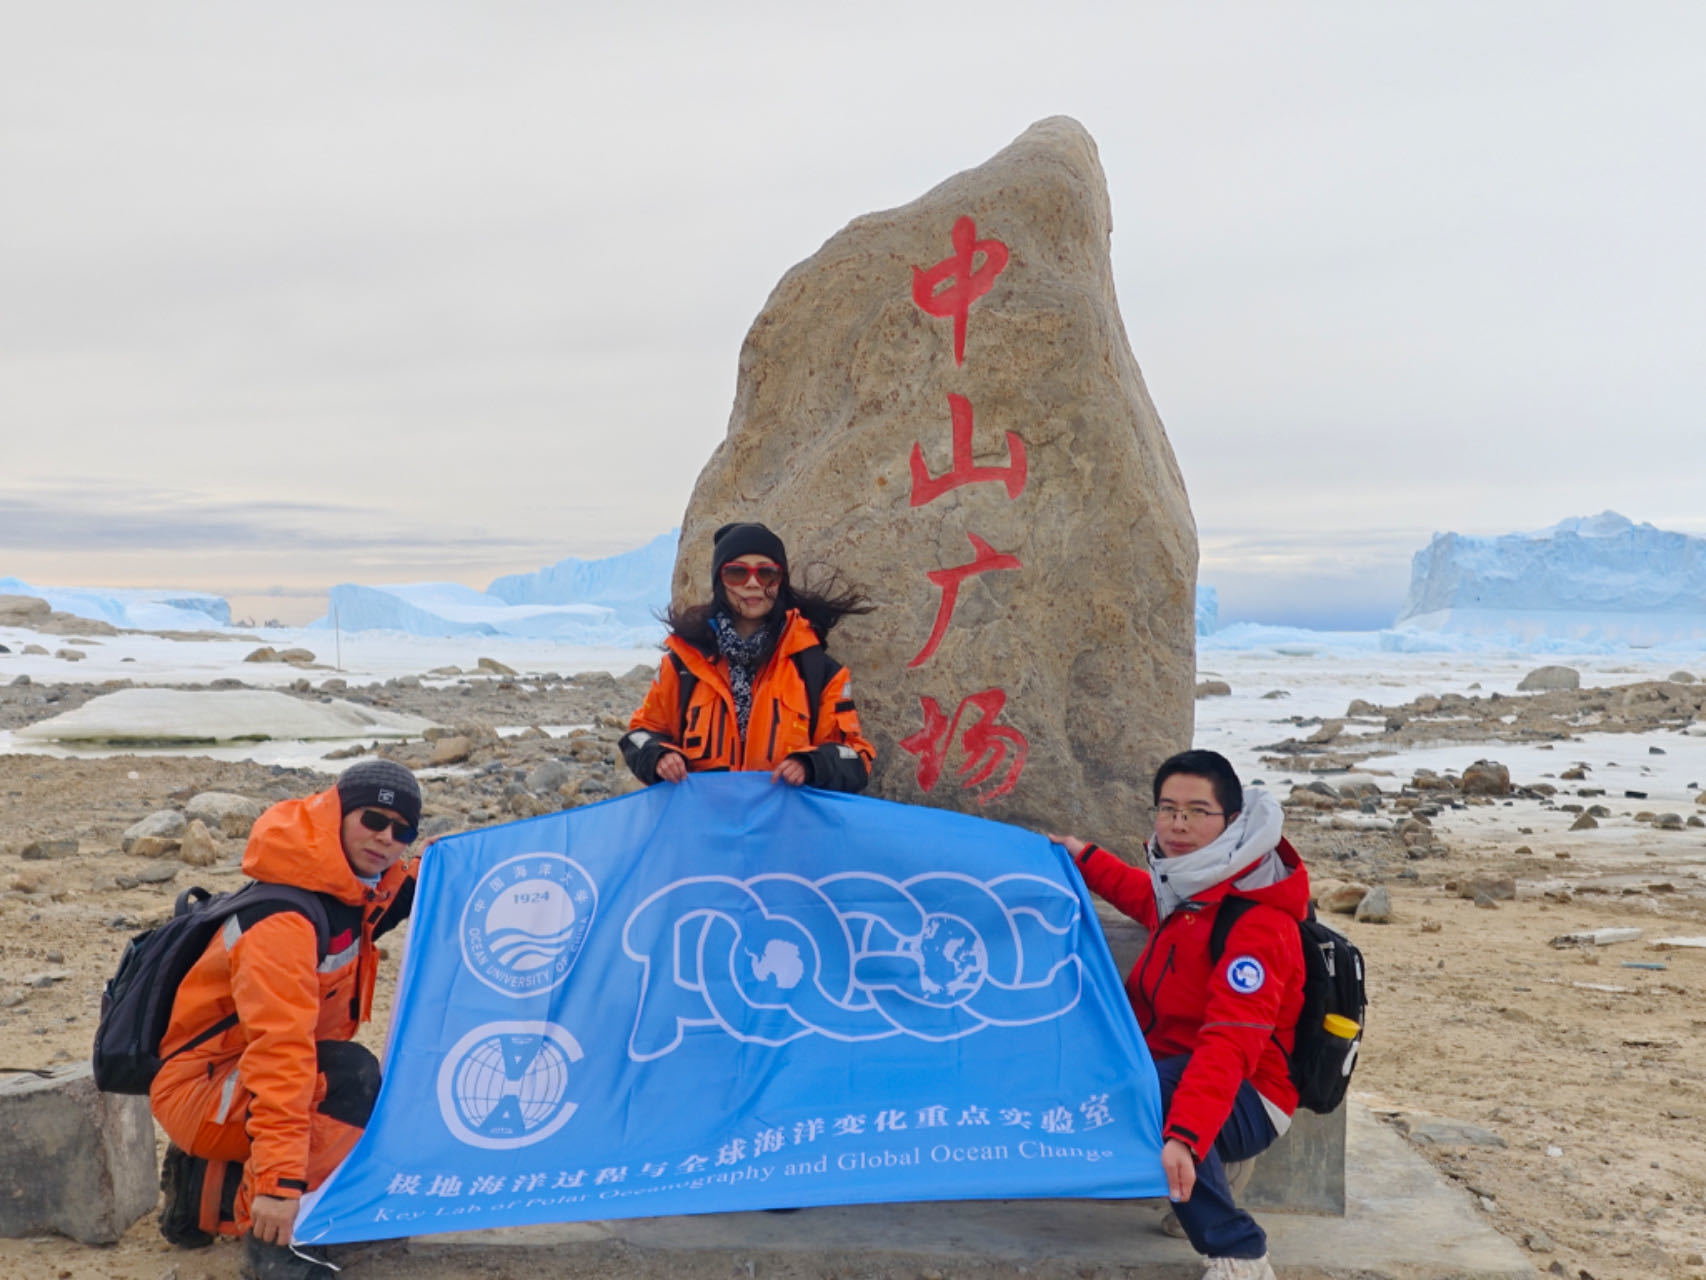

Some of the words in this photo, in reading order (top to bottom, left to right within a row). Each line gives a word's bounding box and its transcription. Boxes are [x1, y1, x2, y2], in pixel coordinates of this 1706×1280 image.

[899, 215, 1029, 807] 中山广场
[513, 891, 550, 904] 1924
[468, 927, 488, 966] OCEAN
[486, 965, 550, 988] UNIVERSITY
[373, 1207, 426, 1223] Key
[435, 1204, 482, 1217] Lab
[599, 1165, 776, 1200] Oceanography
[784, 1154, 827, 1177] and
[837, 1144, 920, 1171] Global
[930, 1142, 1010, 1163] Ocean
[1018, 1140, 1114, 1163] Change
